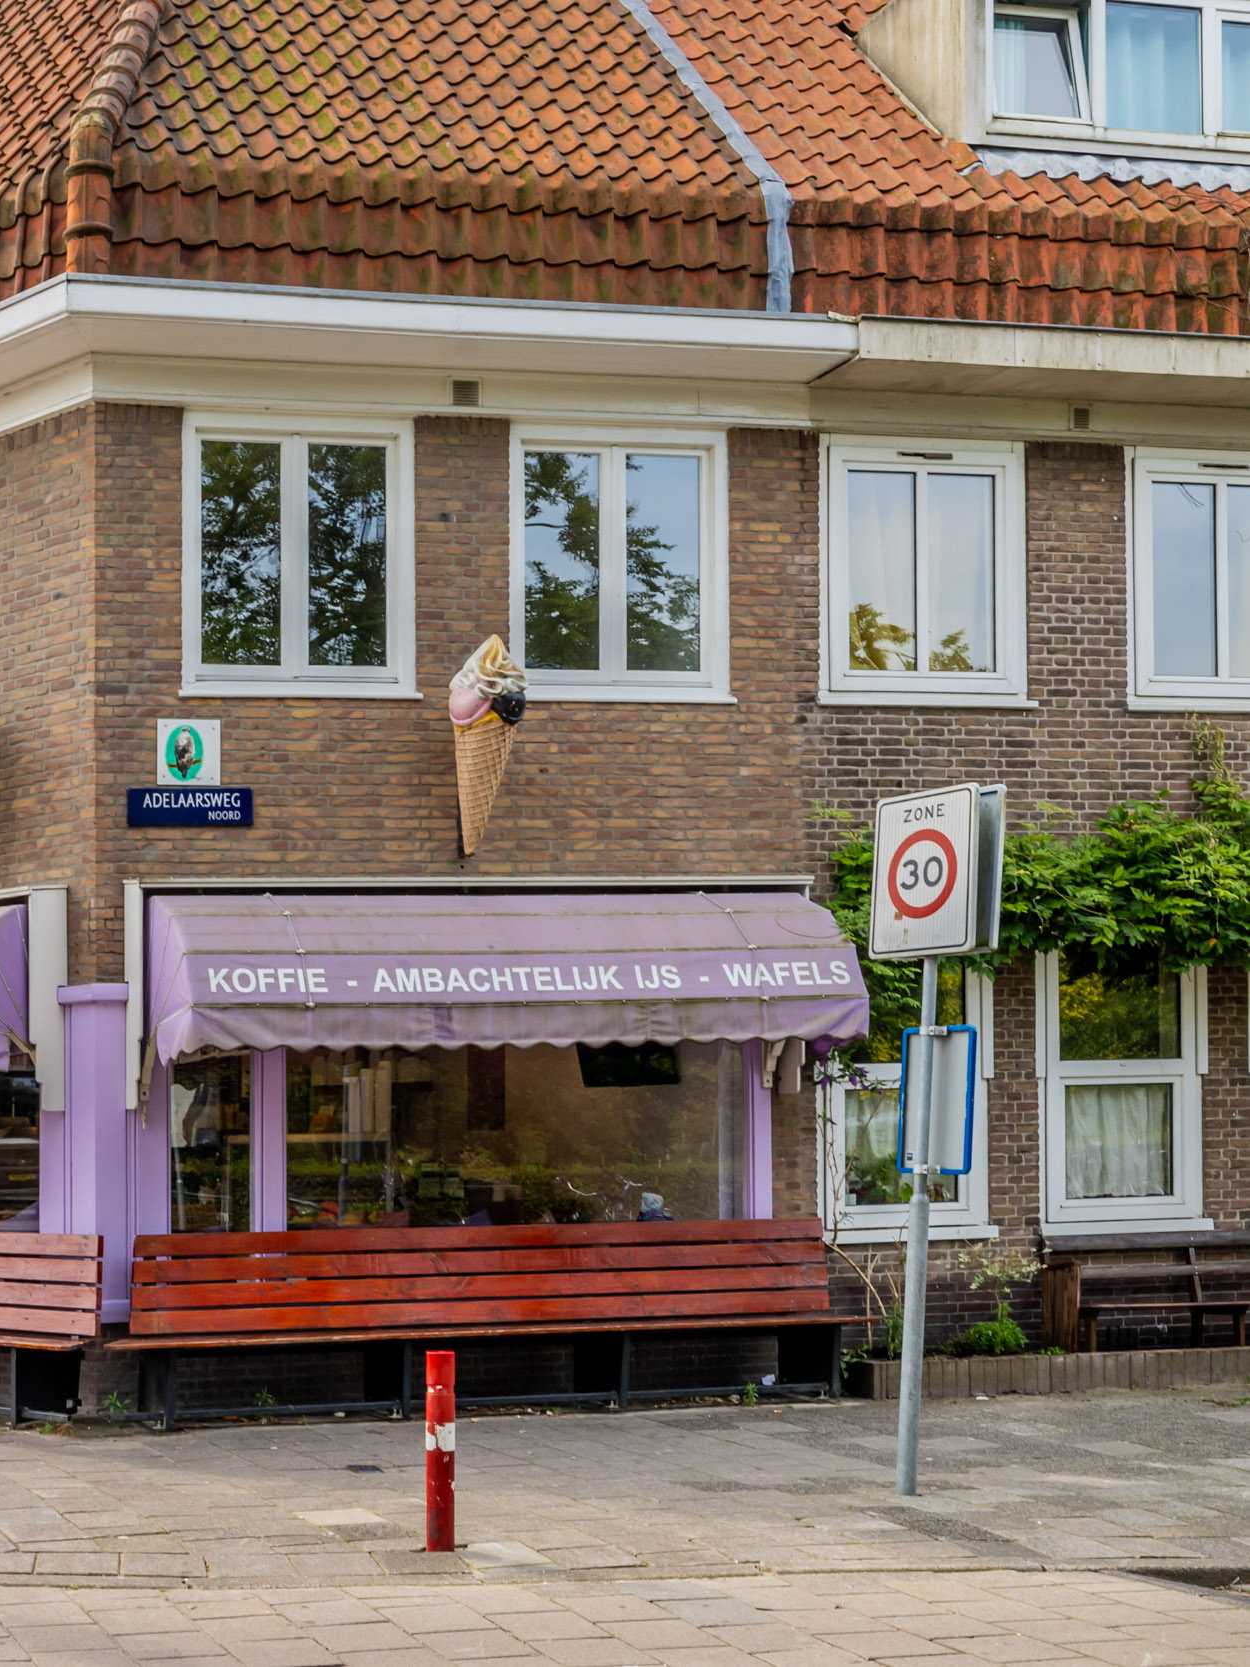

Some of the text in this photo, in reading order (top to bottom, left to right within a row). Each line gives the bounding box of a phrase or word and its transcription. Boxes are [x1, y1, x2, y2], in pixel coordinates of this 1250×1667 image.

[143, 792, 241, 808] ADELAARSWEG
[208, 811, 241, 820] NOORD
[903, 803, 945, 823] ZONE
[900, 856, 943, 890] 30
[208, 967, 329, 993] KOFFIE
[373, 965, 623, 993] AMBACHTELIJK
[634, 965, 682, 989] IJS
[722, 960, 851, 987] WAFELS
